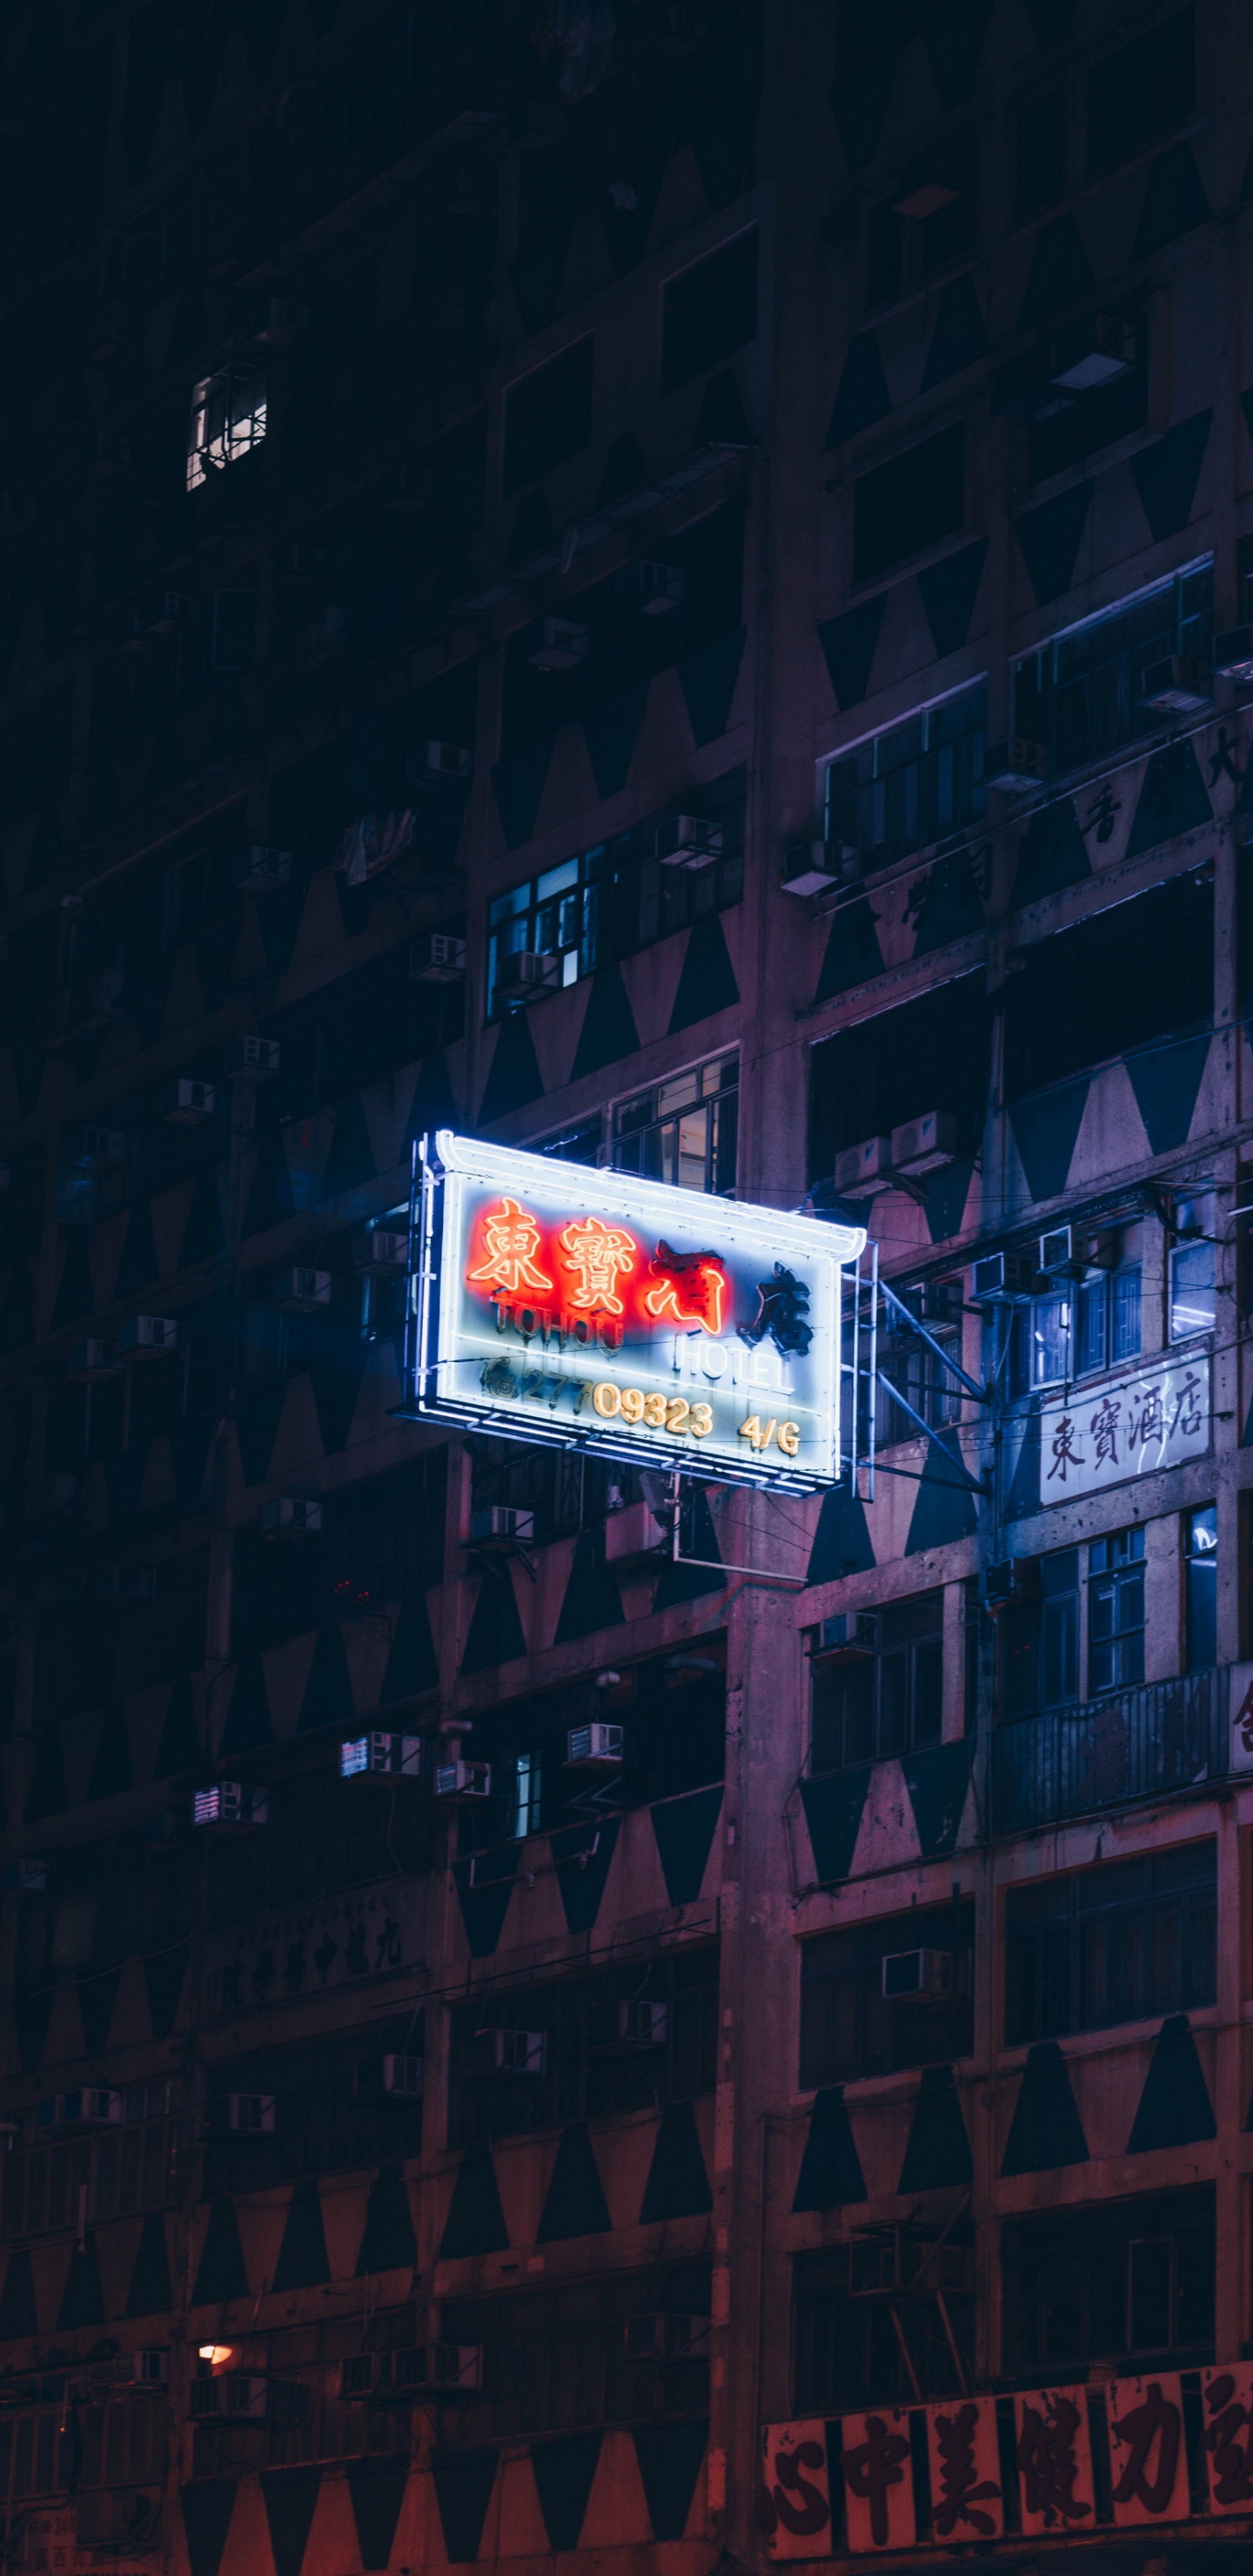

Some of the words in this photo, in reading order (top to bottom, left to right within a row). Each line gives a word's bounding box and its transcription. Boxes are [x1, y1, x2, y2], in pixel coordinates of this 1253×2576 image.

[674, 1333, 794, 1396] HOTEL
[1047, 1371, 1201, 1482] 東寶酒店
